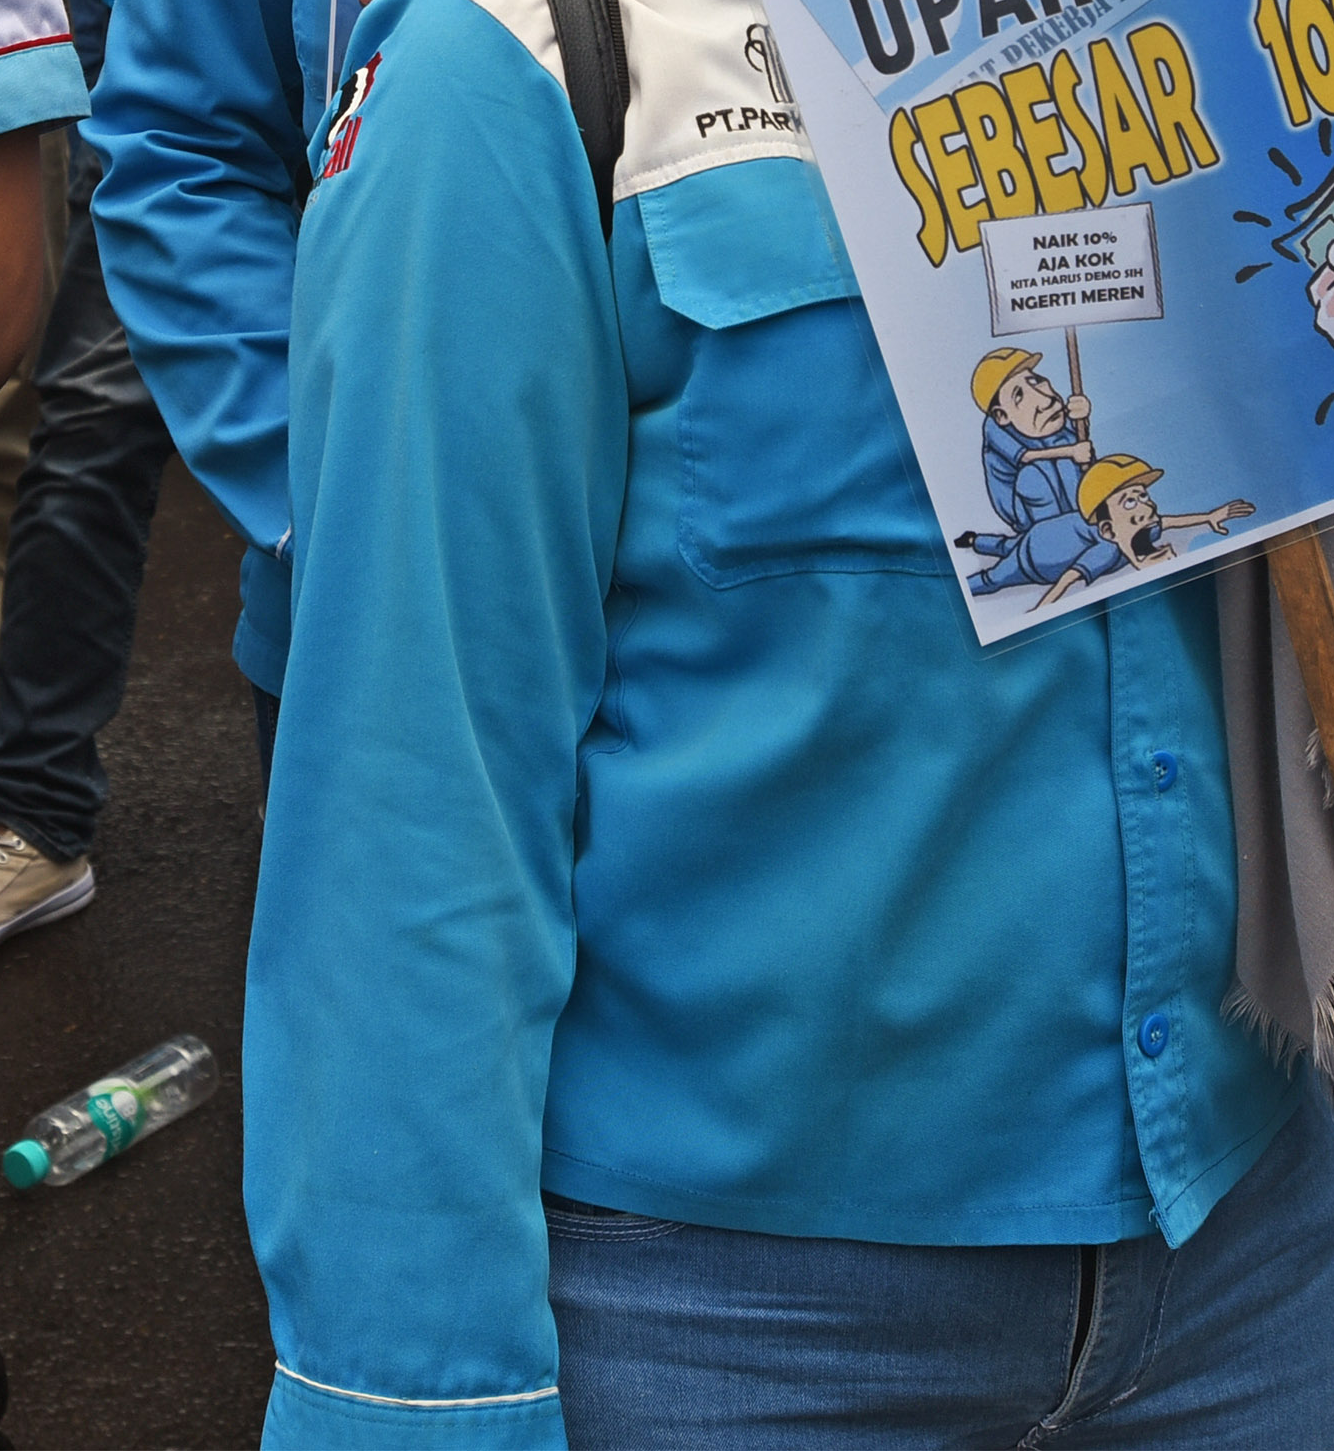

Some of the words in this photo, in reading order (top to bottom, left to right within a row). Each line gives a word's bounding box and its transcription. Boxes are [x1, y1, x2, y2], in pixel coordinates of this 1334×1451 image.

[889, 22, 1220, 268] SEBESAR
[1033, 233, 1079, 250] NAIK
[1083, 231, 1118, 246] 10%
[1037, 255, 1070, 272] AJA
[1075, 251, 1115, 268] KOK
[1010, 277, 1038, 290] KITA
[1041, 273, 1081, 287] HARUS
[1084, 269, 1121, 282] DEMO
[1124, 268, 1144, 278] SIH
[1011, 291, 1077, 312] NGERTI
[1081, 285, 1145, 304] MEREN
